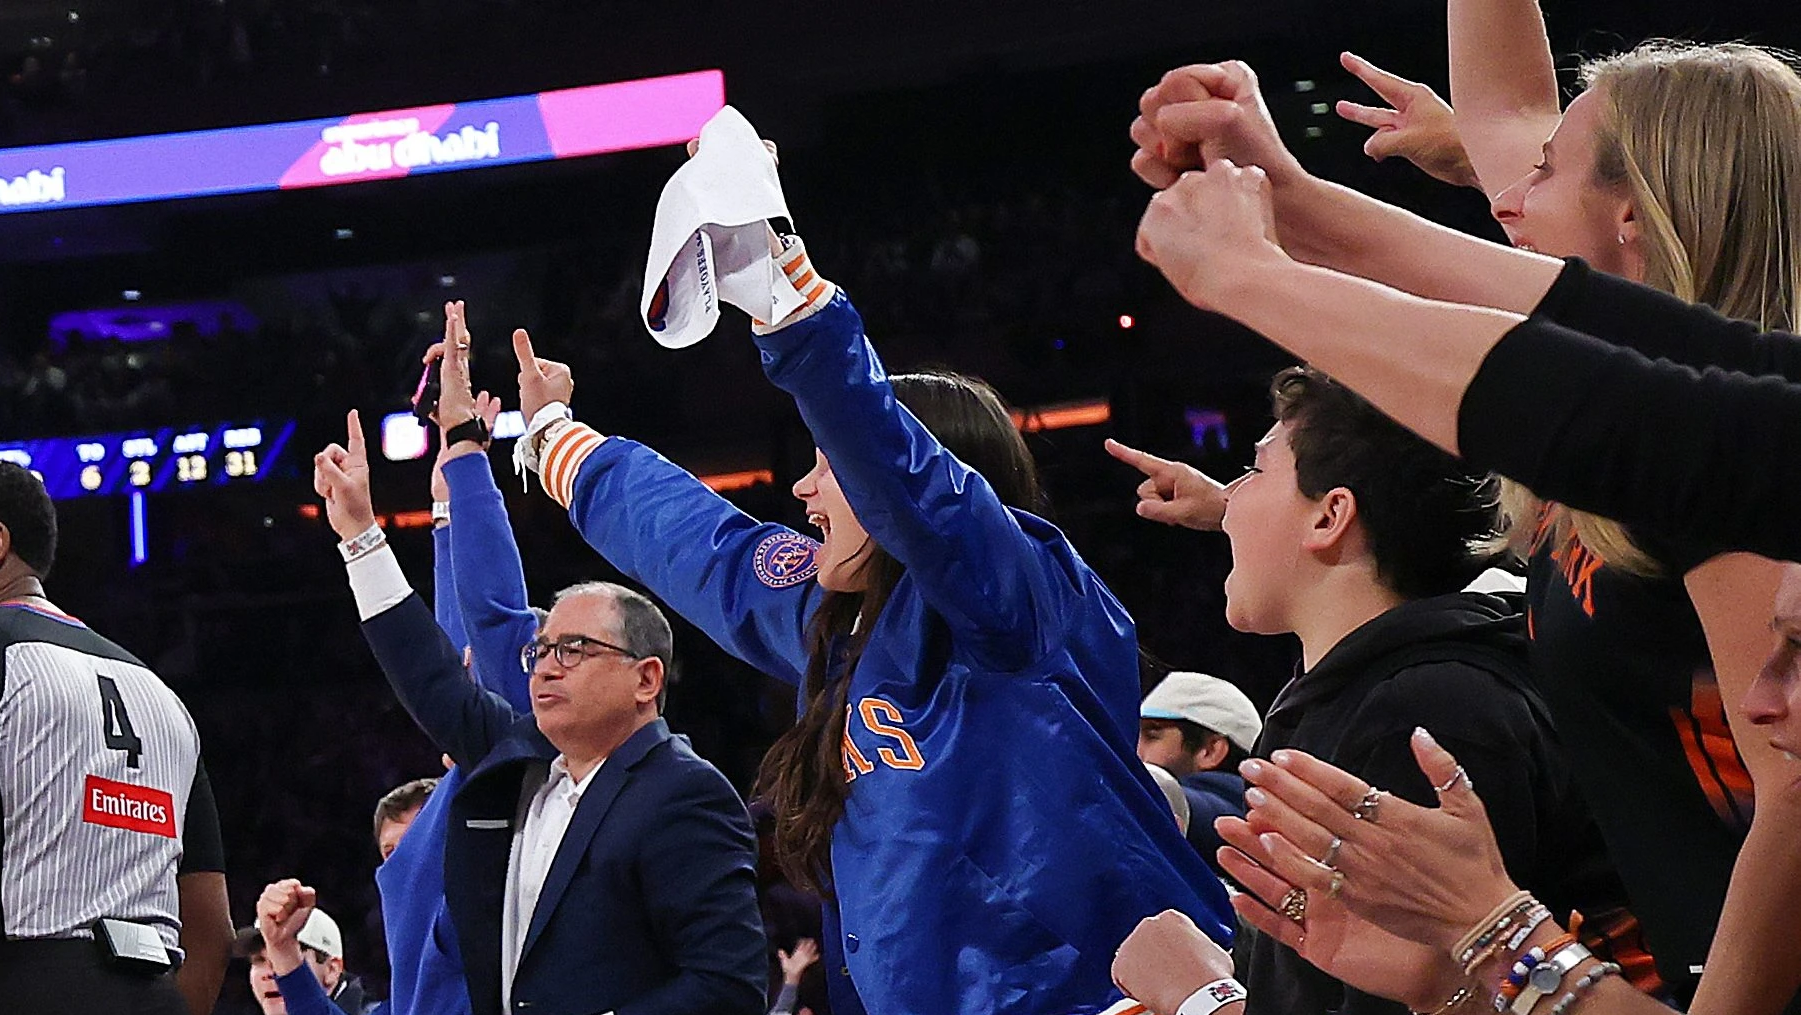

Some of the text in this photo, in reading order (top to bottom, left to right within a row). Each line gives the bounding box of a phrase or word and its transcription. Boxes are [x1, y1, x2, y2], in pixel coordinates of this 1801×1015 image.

[320, 121, 500, 176] abu dhabi
[98, 673, 142, 769] 4
[91, 787, 167, 824] Emirates
